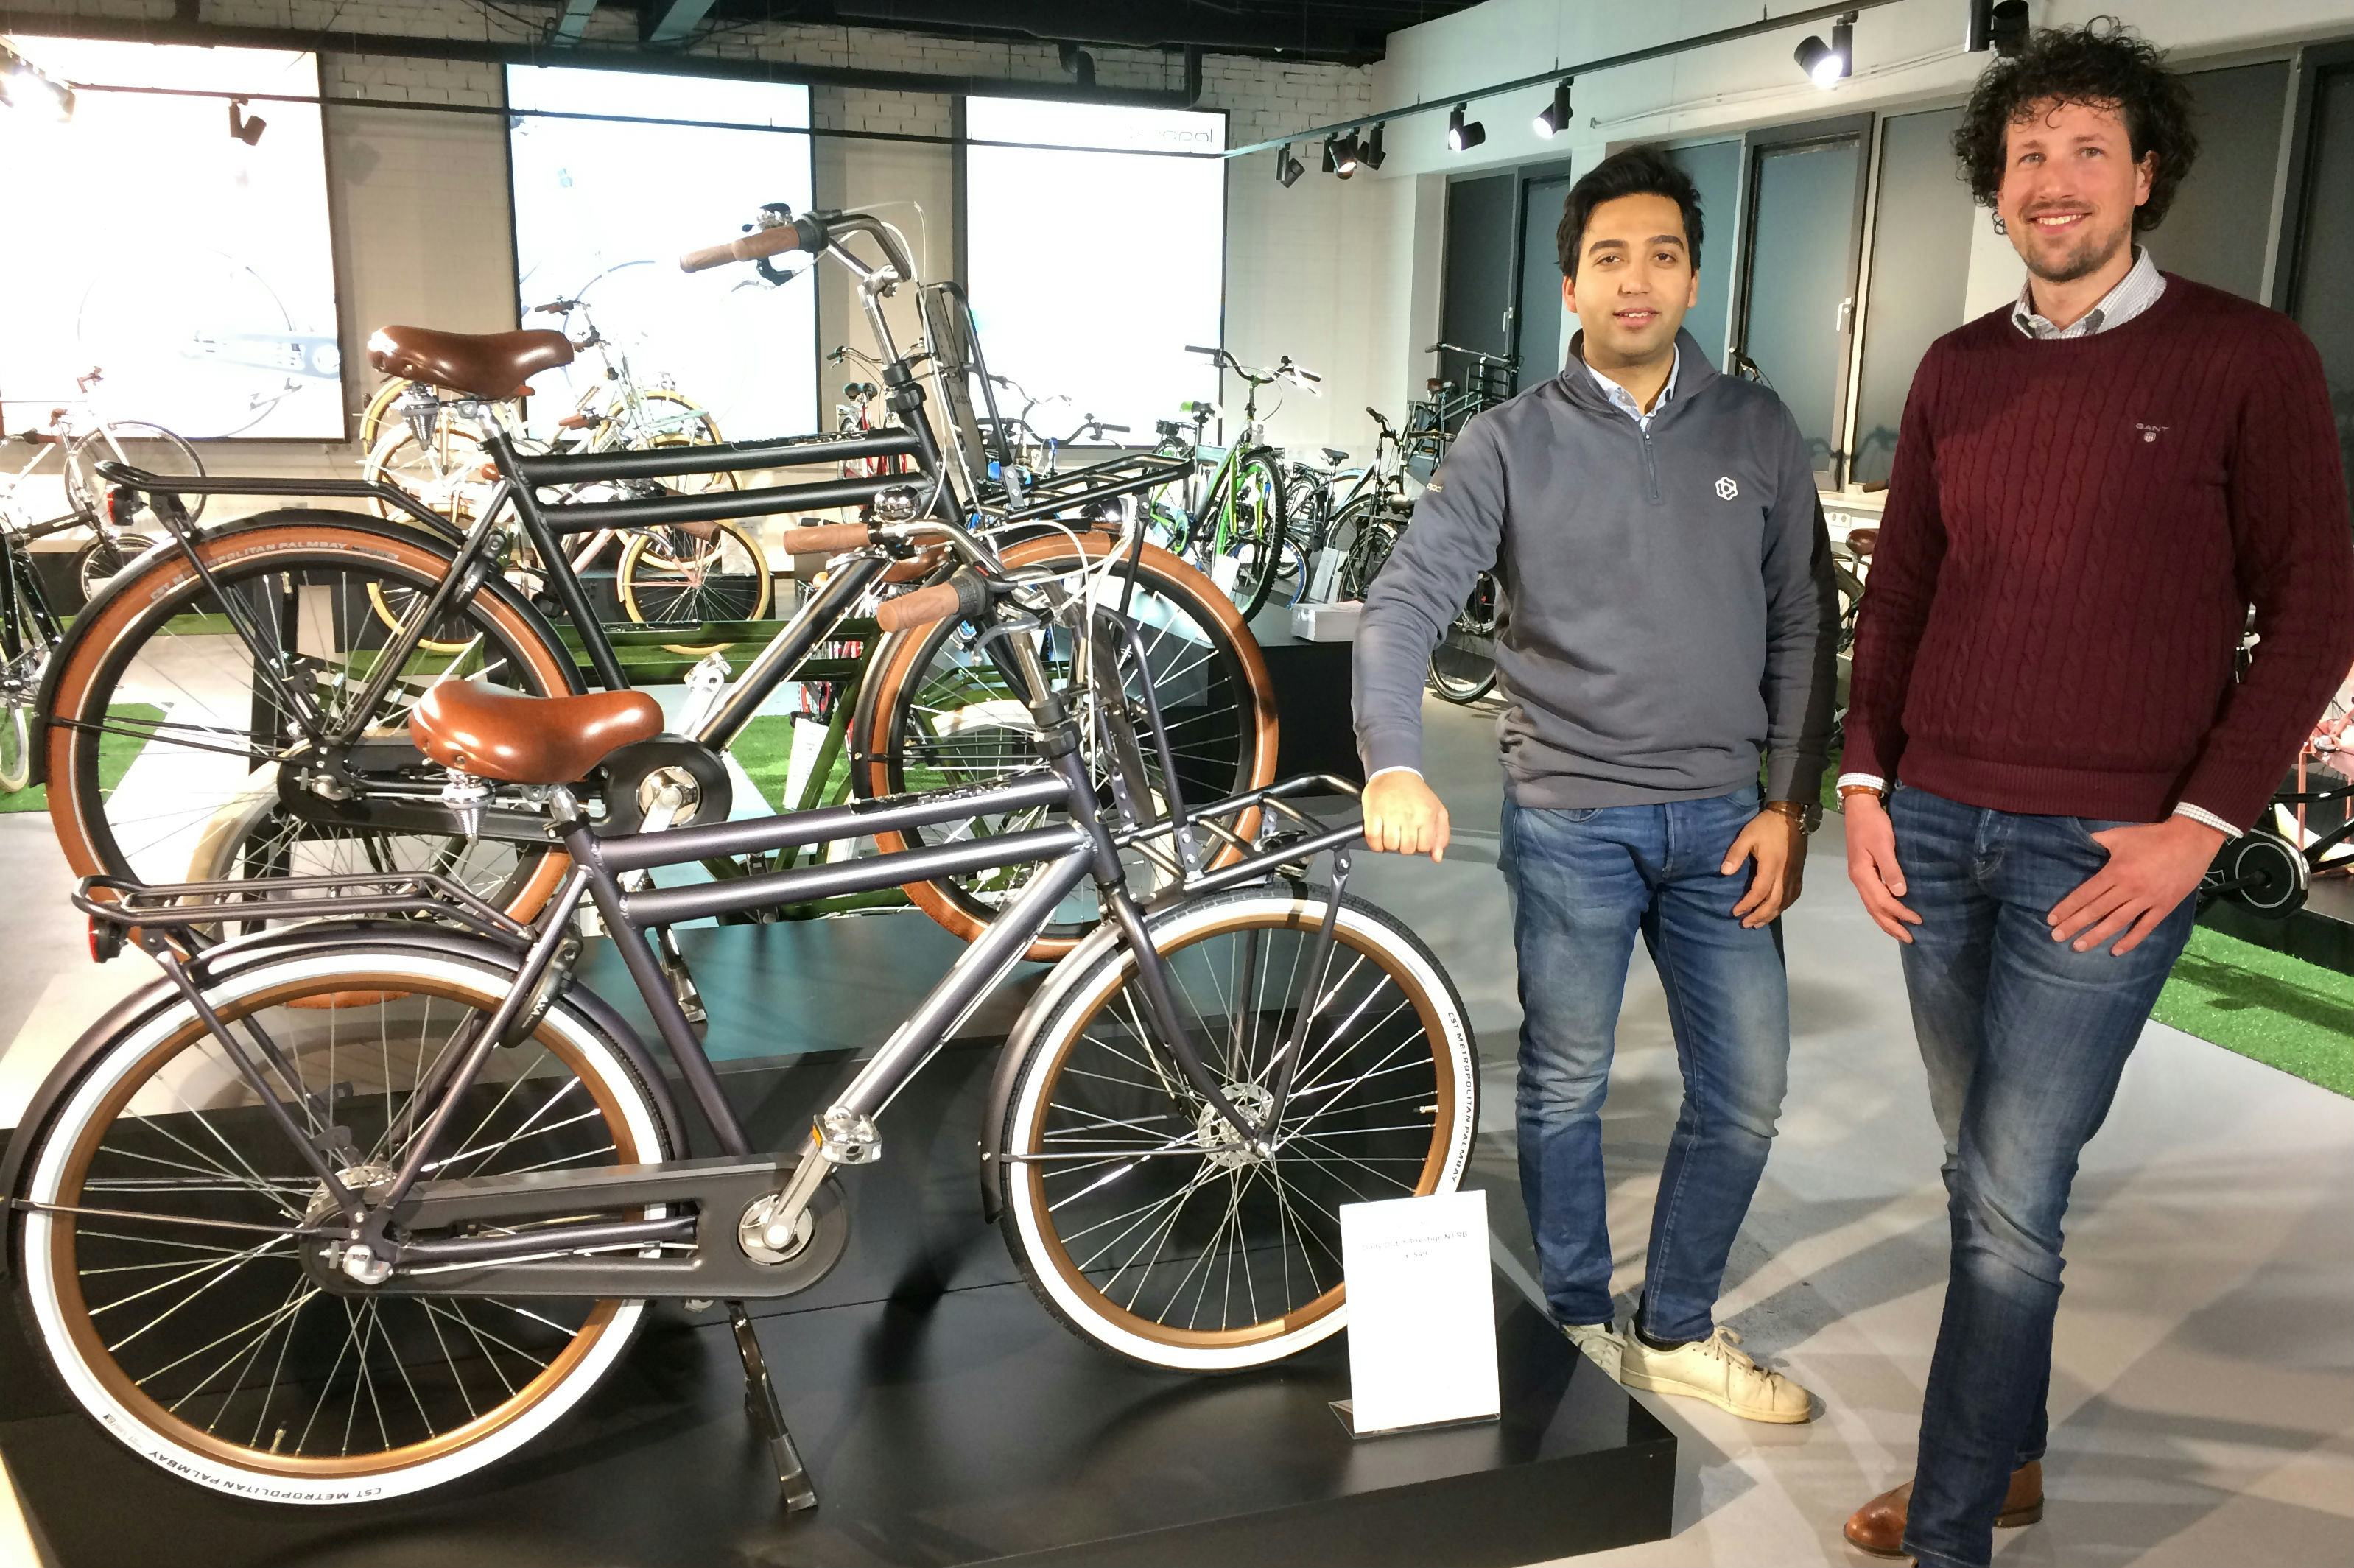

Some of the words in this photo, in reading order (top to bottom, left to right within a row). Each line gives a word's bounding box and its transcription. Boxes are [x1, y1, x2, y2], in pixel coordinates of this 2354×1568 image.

[2135, 423, 2170, 432] GANT
[278, 541, 348, 550] PALMBAY
[530, 994, 549, 1016] AXA
[1448, 1012, 1460, 1029] CST
[1456, 1033, 1472, 1122] METROPOLITAN
[1451, 1126, 1470, 1183] PALMBAY
[149, 1451, 221, 1485] PALMBAY
[223, 1480, 350, 1500] METROPOLITAN
[355, 1487, 382, 1498] CST
